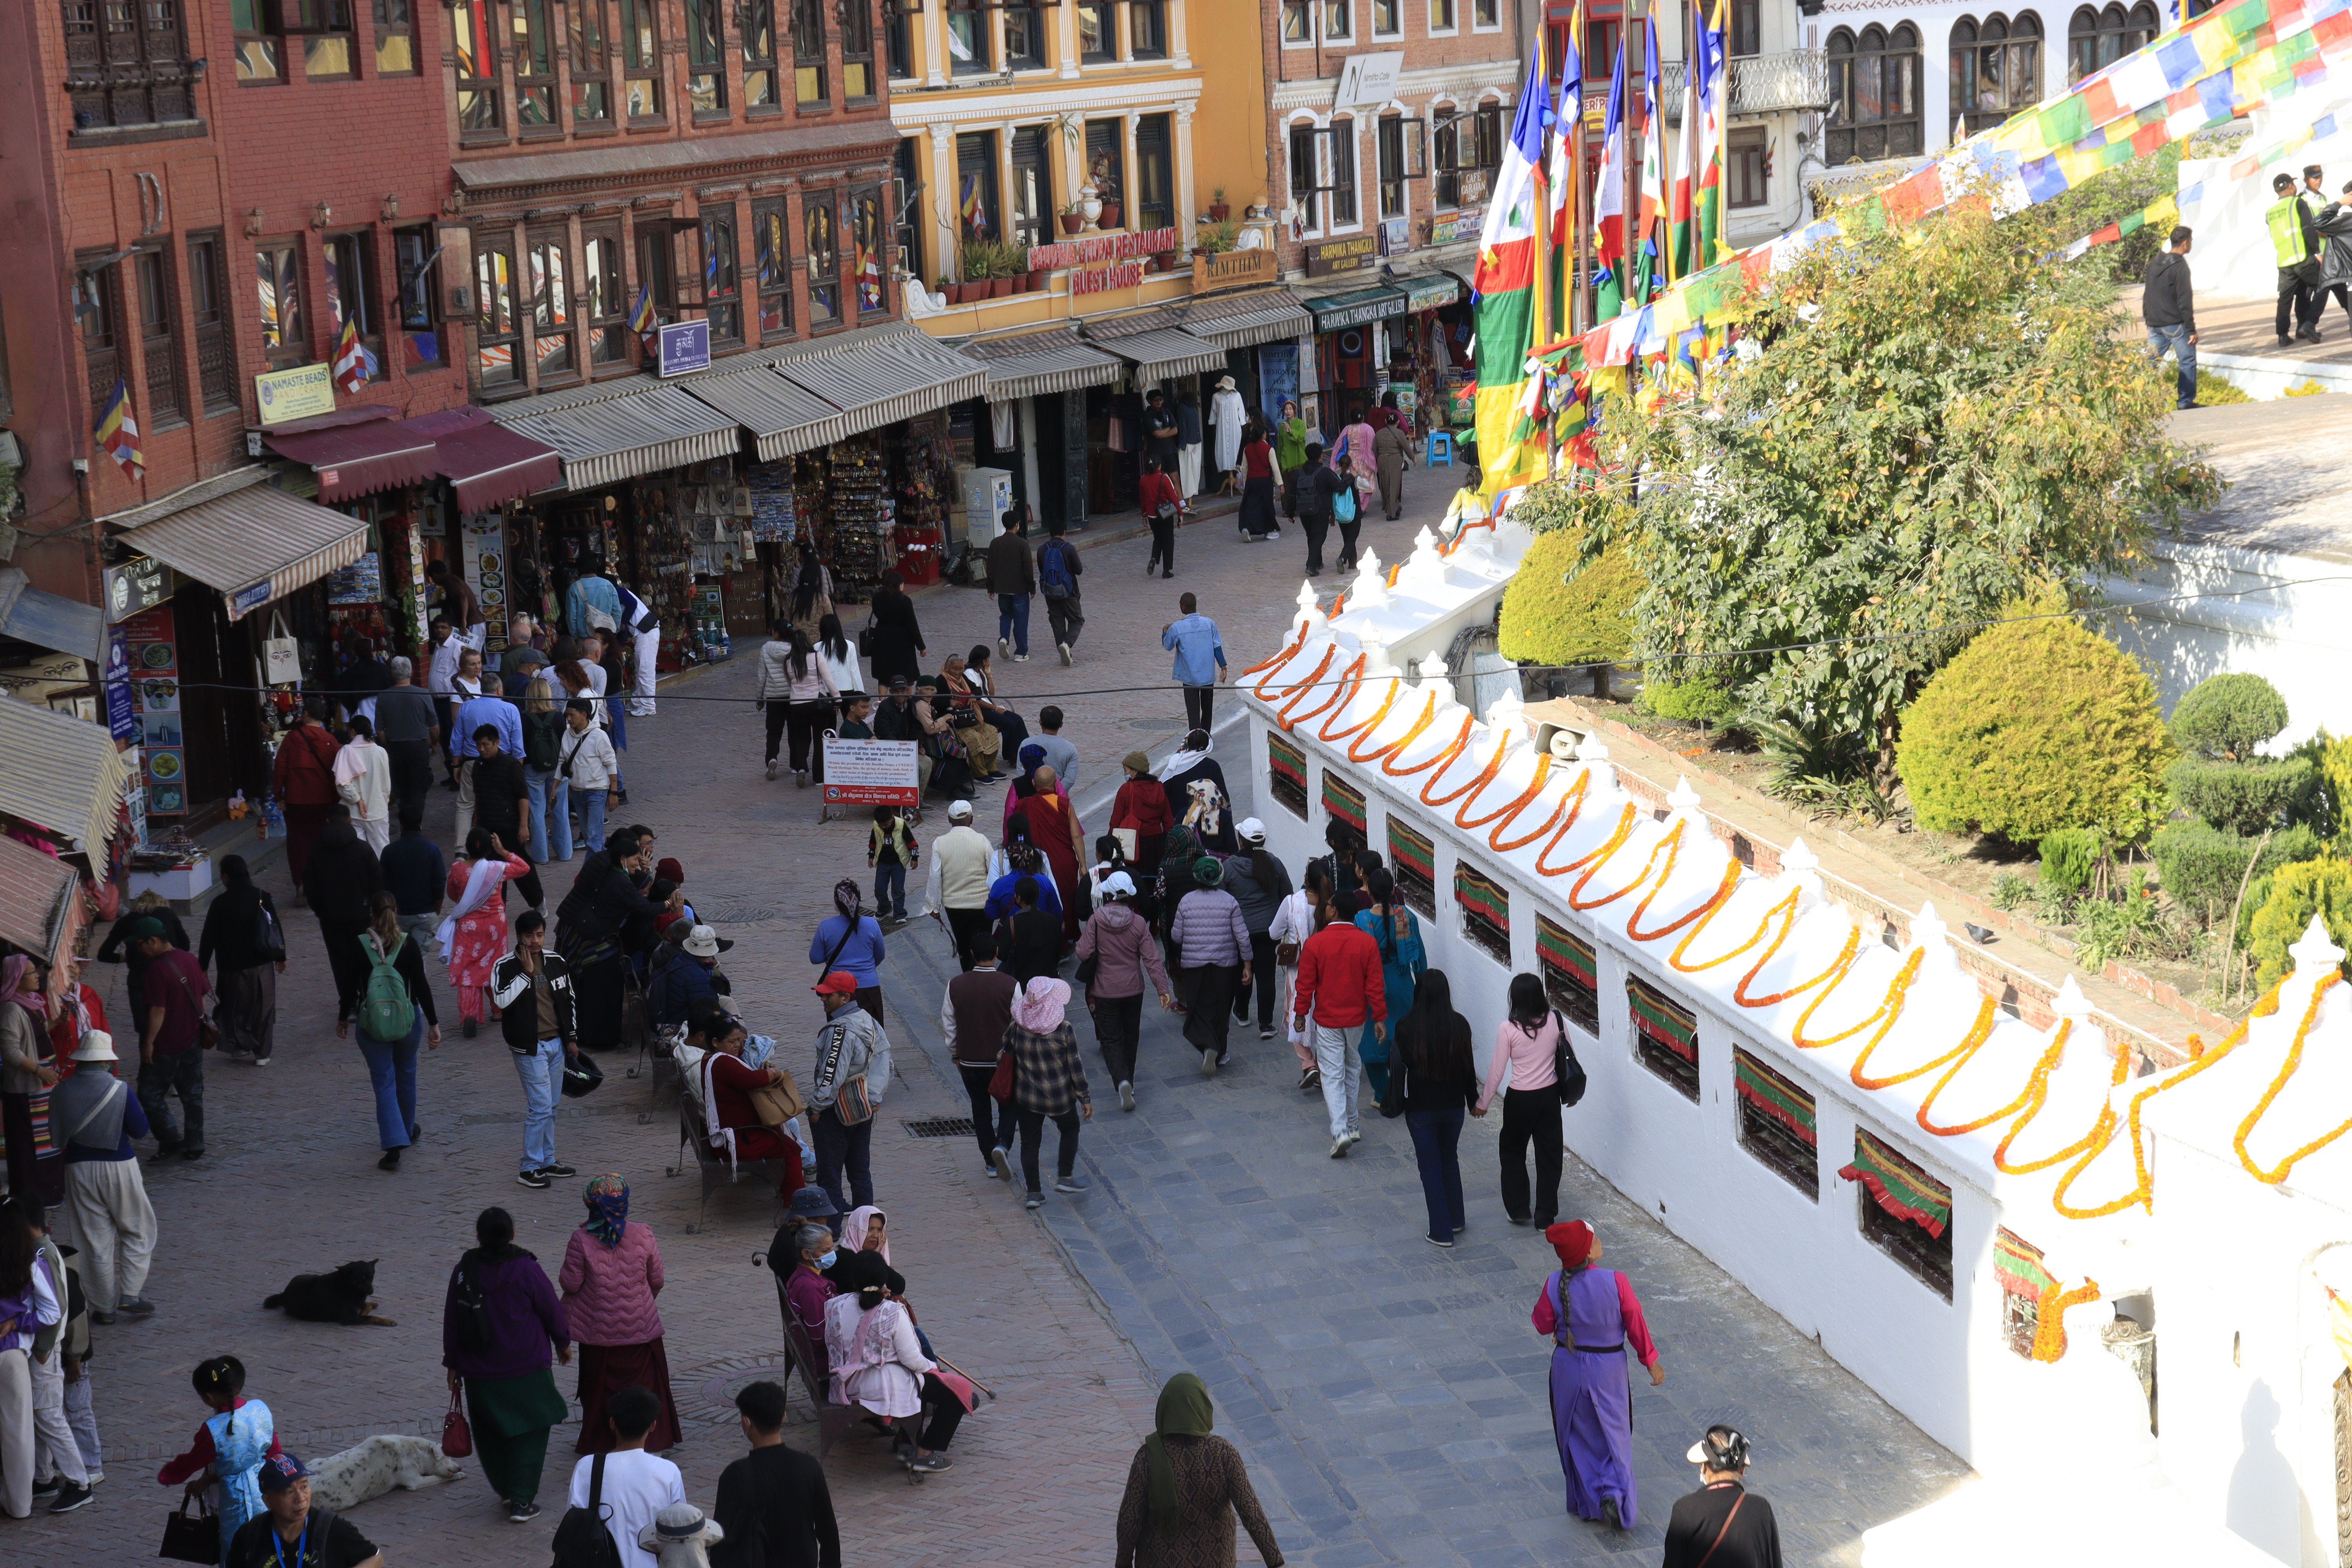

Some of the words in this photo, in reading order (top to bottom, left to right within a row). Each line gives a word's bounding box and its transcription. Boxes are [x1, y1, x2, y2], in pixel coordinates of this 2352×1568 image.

[1461, 180, 1486, 194] CARAVAN
[2269, 208, 2287, 216] MODERN
[2269, 213, 2286, 221] SECURITY
[1028, 242, 1076, 271] BOUDHA
[1077, 237, 1112, 264] STUPA
[1114, 227, 1177, 258] RESTAURANT
[1320, 242, 1347, 260] HARMIKA
[1347, 238, 1373, 255] THANGKA
[1207, 255, 1261, 278] RIMTHIM
[1332, 260, 1340, 270] ART
[1341, 258, 1358, 269] GALLERY
[1071, 269, 1106, 295] GUEST
[1107, 263, 1142, 290] HOUSE
[1414, 289, 1426, 298] STUPA
[1442, 283, 1458, 291] KITCHEN
[1321, 310, 1348, 329] HARMIKA
[1350, 305, 1377, 323] THANGKA
[1377, 301, 1387, 318] ART
[272, 375, 303, 390] NAMASTE
[305, 370, 327, 384] BEADS
[273, 382, 328, 400] HANDICRAFTS
[453, 634, 470, 644] LASSI
